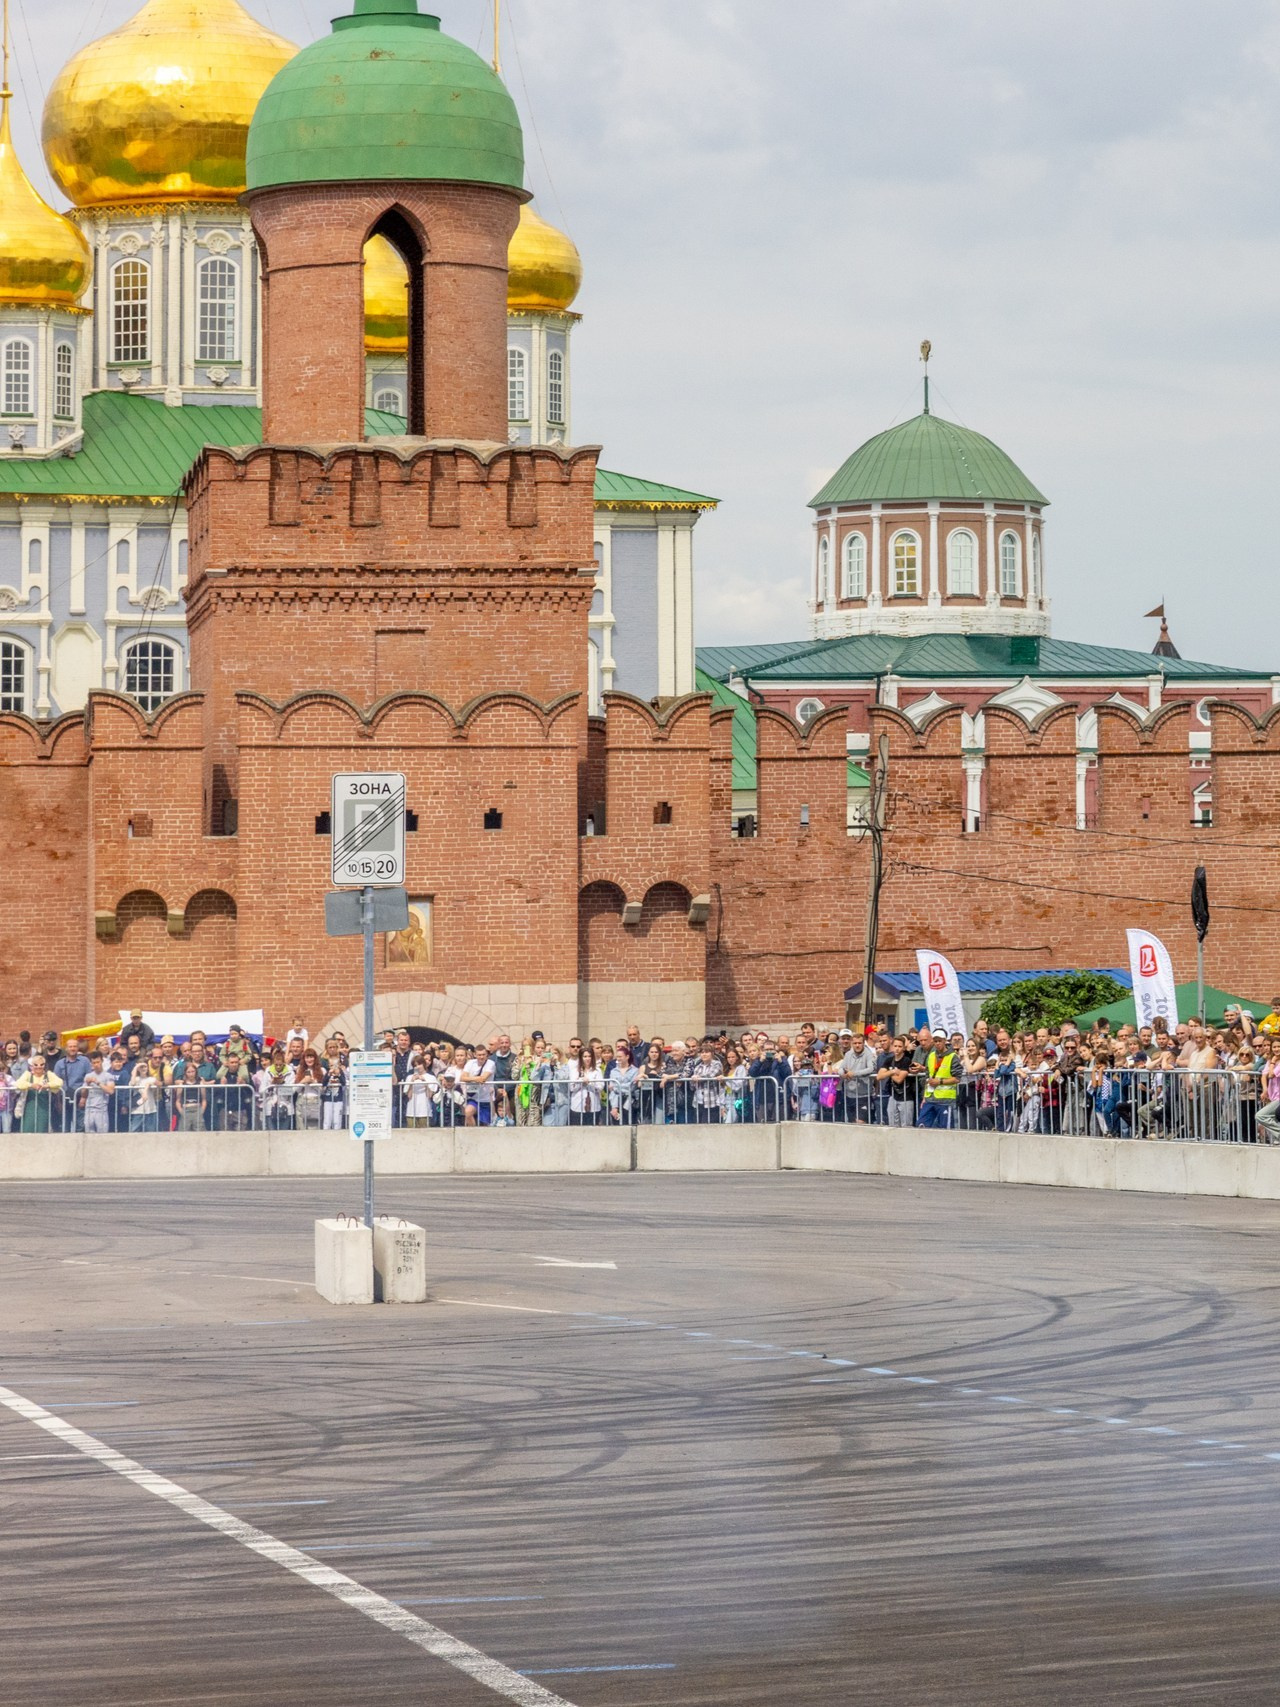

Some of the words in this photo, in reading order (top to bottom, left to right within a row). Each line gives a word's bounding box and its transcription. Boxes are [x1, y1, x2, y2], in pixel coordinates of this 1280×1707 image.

[349, 783, 392, 795] ЗОНА
[348, 864, 357, 873] 10
[361, 862, 372, 874] 15
[376, 860, 395, 874] 20
